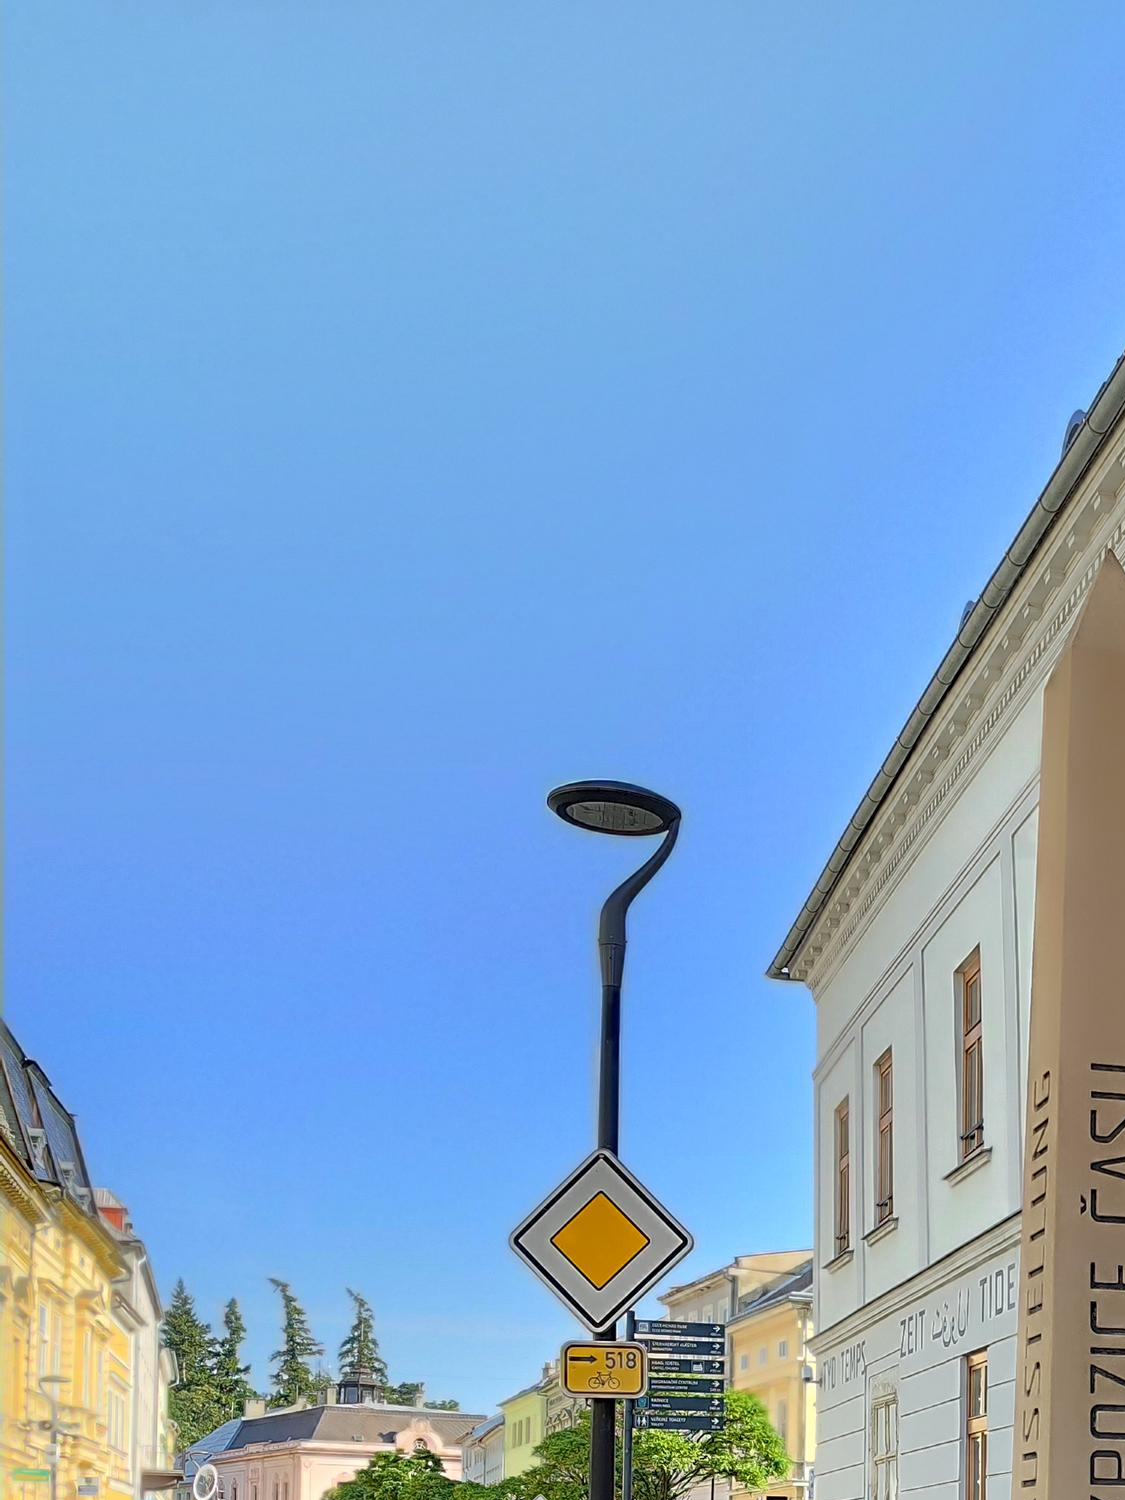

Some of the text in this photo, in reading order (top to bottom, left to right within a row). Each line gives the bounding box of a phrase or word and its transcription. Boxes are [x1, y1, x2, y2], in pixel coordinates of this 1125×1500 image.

[979, 1263, 1016, 1323] TIDE
[604, 1351, 637, 1369] 518
[841, 1340, 867, 1385] TEMPS
[900, 1309, 926, 1358] ZEIT
